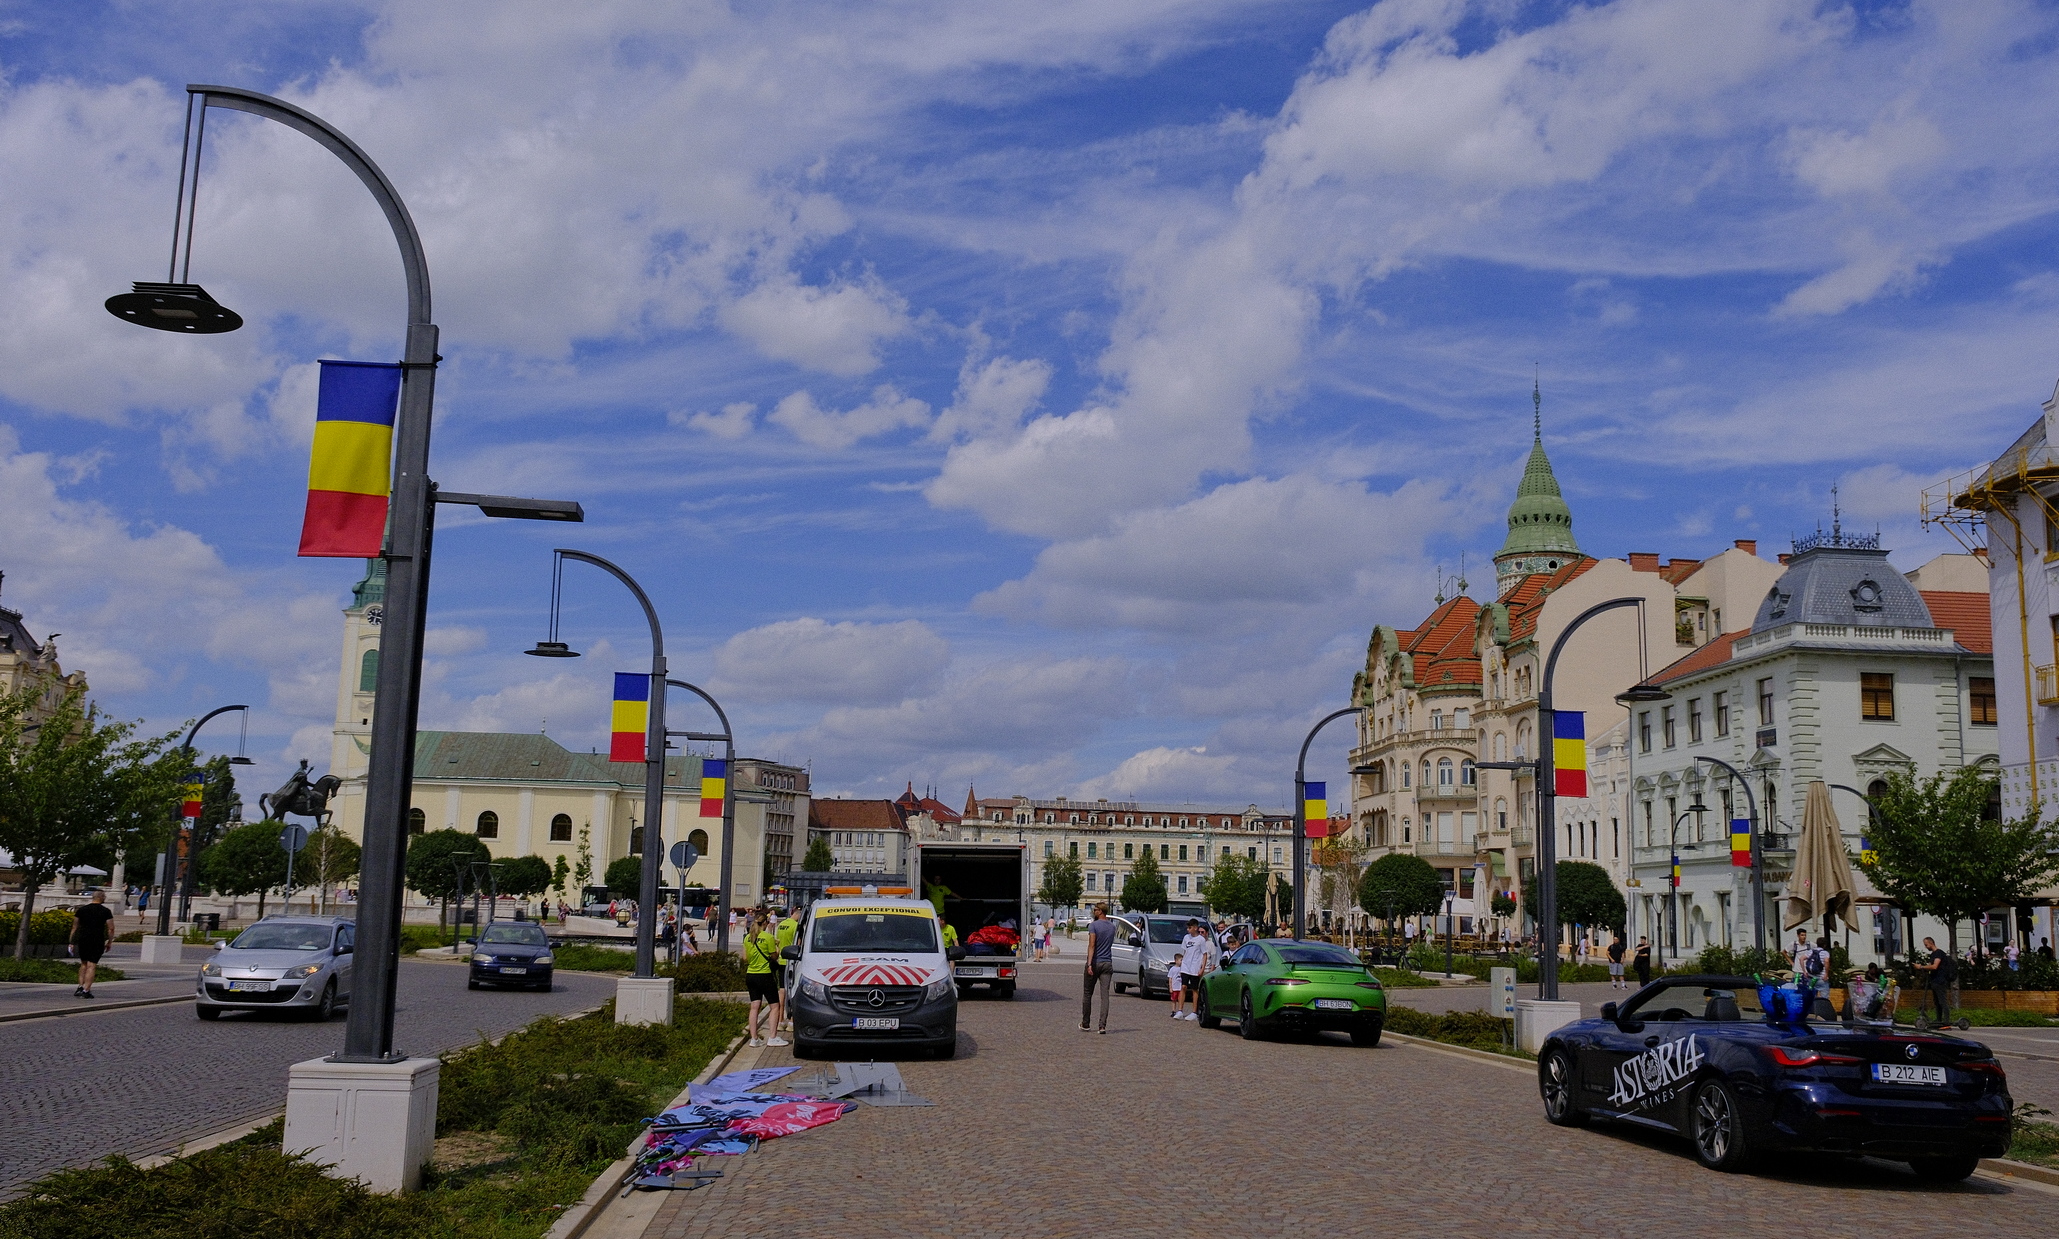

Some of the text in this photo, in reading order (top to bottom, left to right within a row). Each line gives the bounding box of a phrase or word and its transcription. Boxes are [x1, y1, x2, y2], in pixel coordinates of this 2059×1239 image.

[858, 1019, 897, 1027] B 03 EPU
[1607, 1033, 1705, 1108] ASTORIA
[1881, 1065, 1941, 1082] B 212 AIE
[1640, 1088, 1675, 1110] WINES
